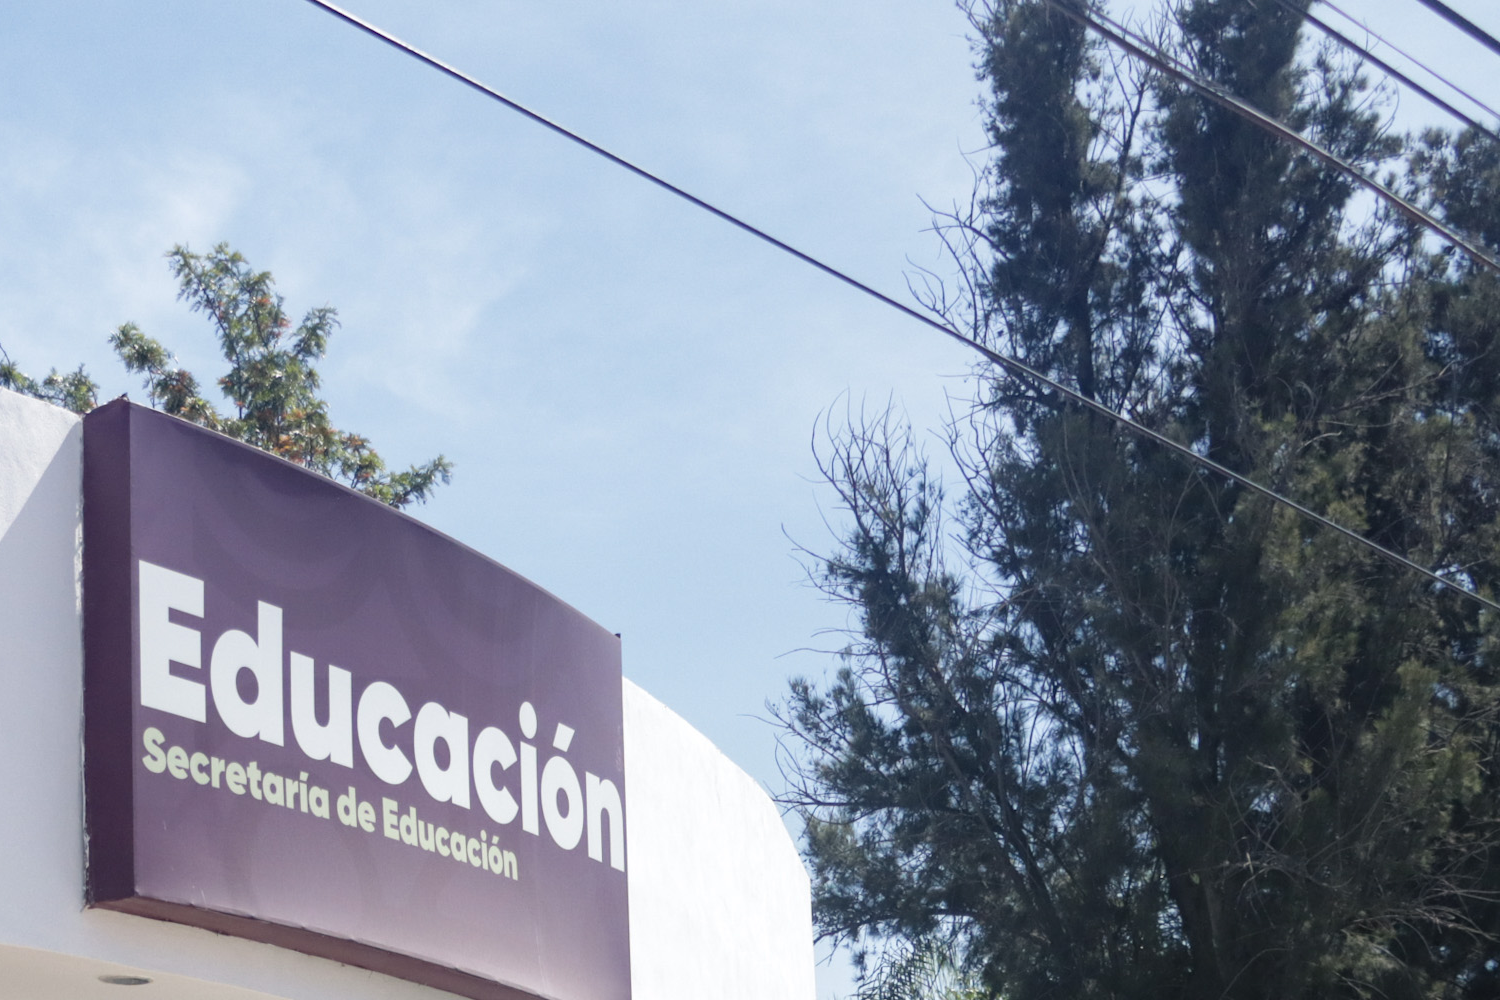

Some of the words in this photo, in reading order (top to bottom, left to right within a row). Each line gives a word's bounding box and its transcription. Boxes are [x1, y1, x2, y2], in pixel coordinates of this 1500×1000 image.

[138, 559, 626, 873] Educación
[142, 727, 330, 820] Secretaría
[336, 785, 377, 833] de
[381, 796, 519, 881] Educación
